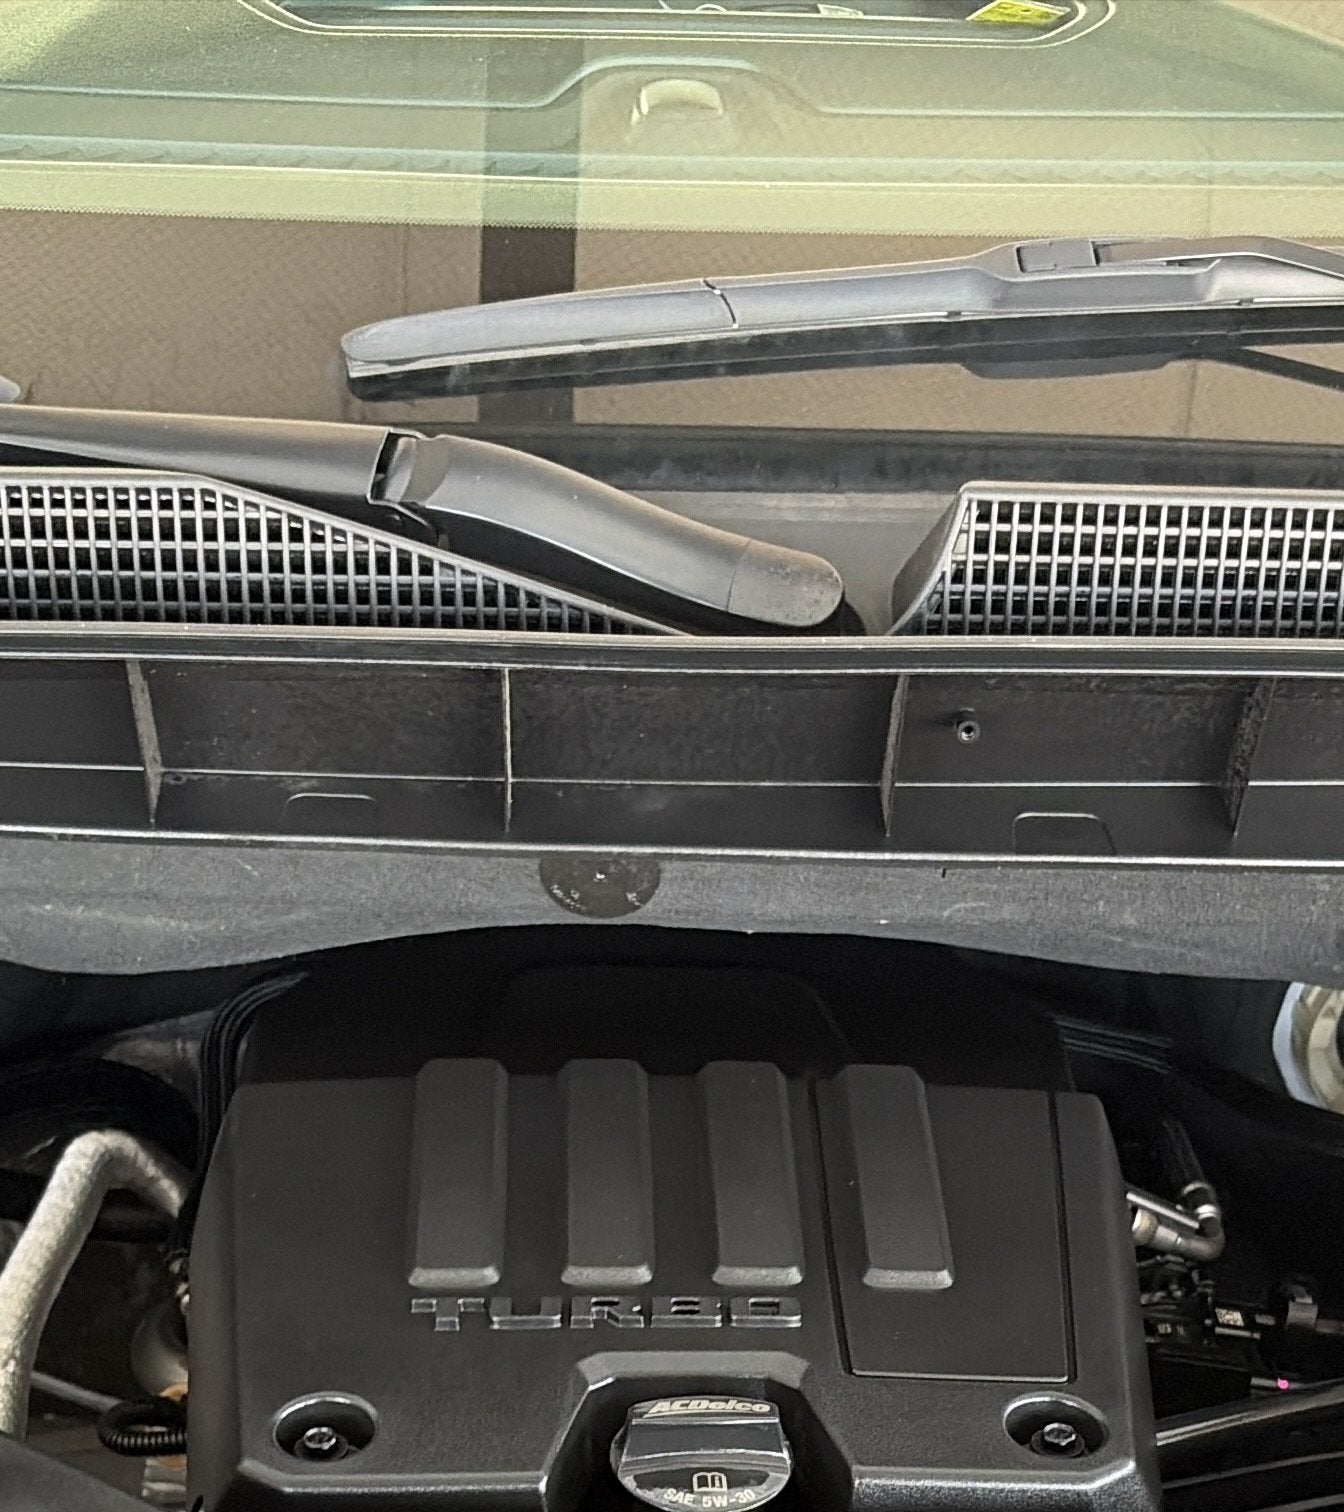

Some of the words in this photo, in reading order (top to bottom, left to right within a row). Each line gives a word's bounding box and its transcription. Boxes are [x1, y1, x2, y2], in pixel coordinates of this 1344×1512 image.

[410, 1296, 803, 1332] TURBO
[646, 1399, 772, 1416] ACDelco
[663, 1488, 695, 1505] SAE
[701, 1488, 756, 1508] 5W-30
